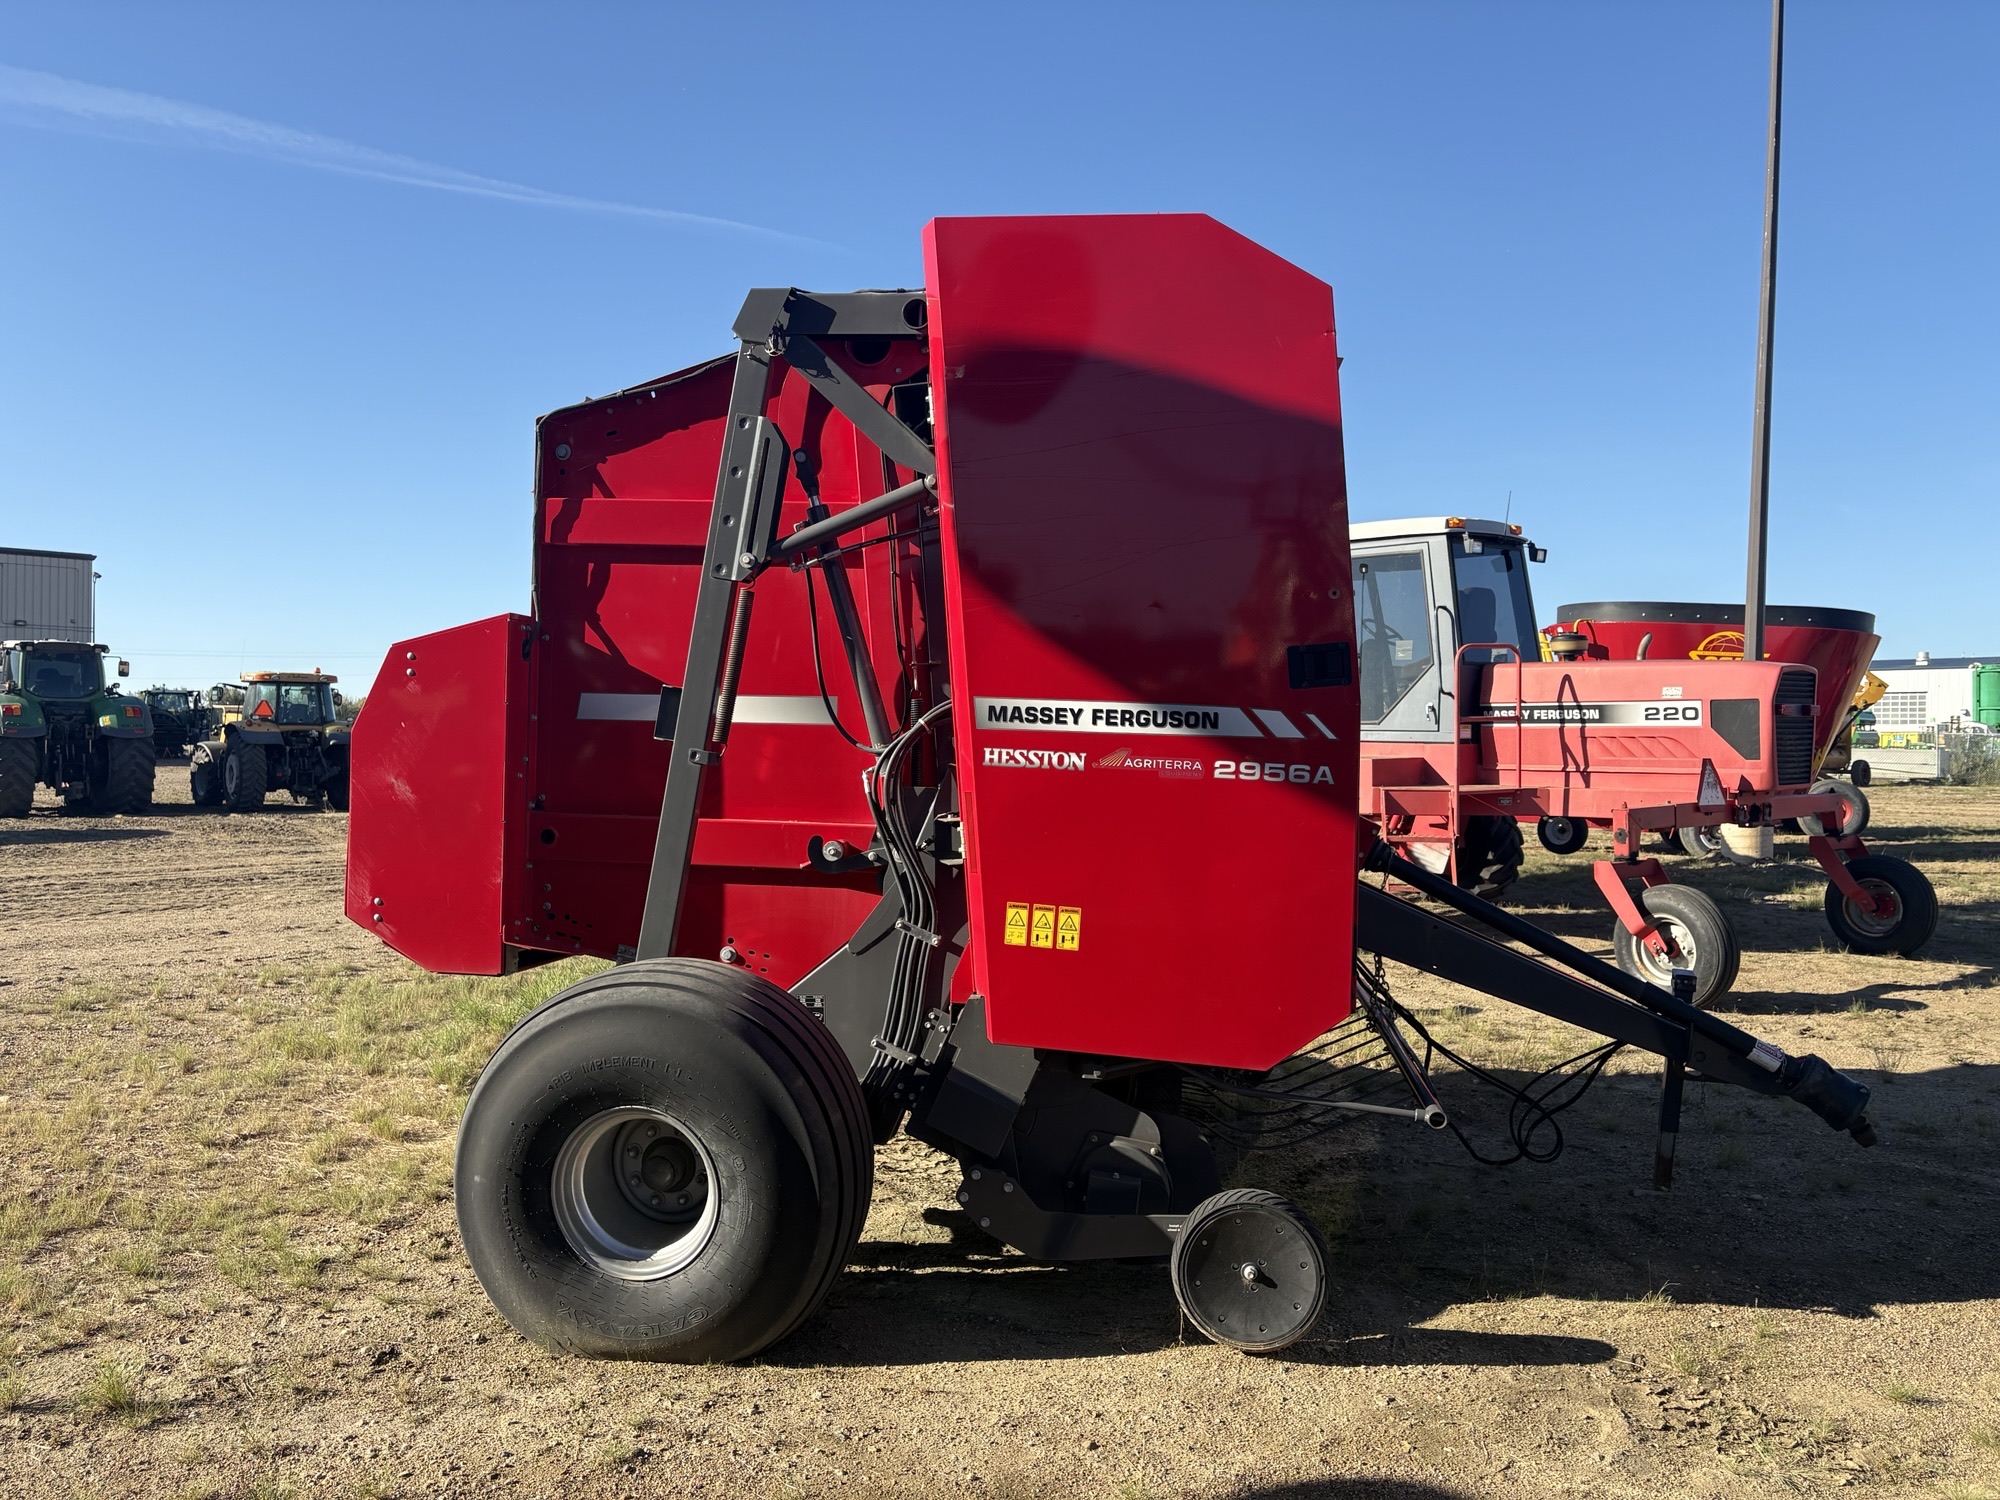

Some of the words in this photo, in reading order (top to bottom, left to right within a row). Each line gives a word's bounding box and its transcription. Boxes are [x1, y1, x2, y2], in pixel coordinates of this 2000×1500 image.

[987, 705, 1083, 725] MASSEY
[1091, 708, 1219, 730] FERGUSON
[1484, 709, 1531, 720] MASSY
[1534, 709, 1600, 720] FERGUSON
[1644, 707, 1699, 720] 220
[982, 747, 1087, 771] HESSTON
[1124, 758, 1202, 771] AGRITERRA
[1213, 760, 1335, 785] 2956A
[581, 1056, 657, 1075] IMPLEMENT
